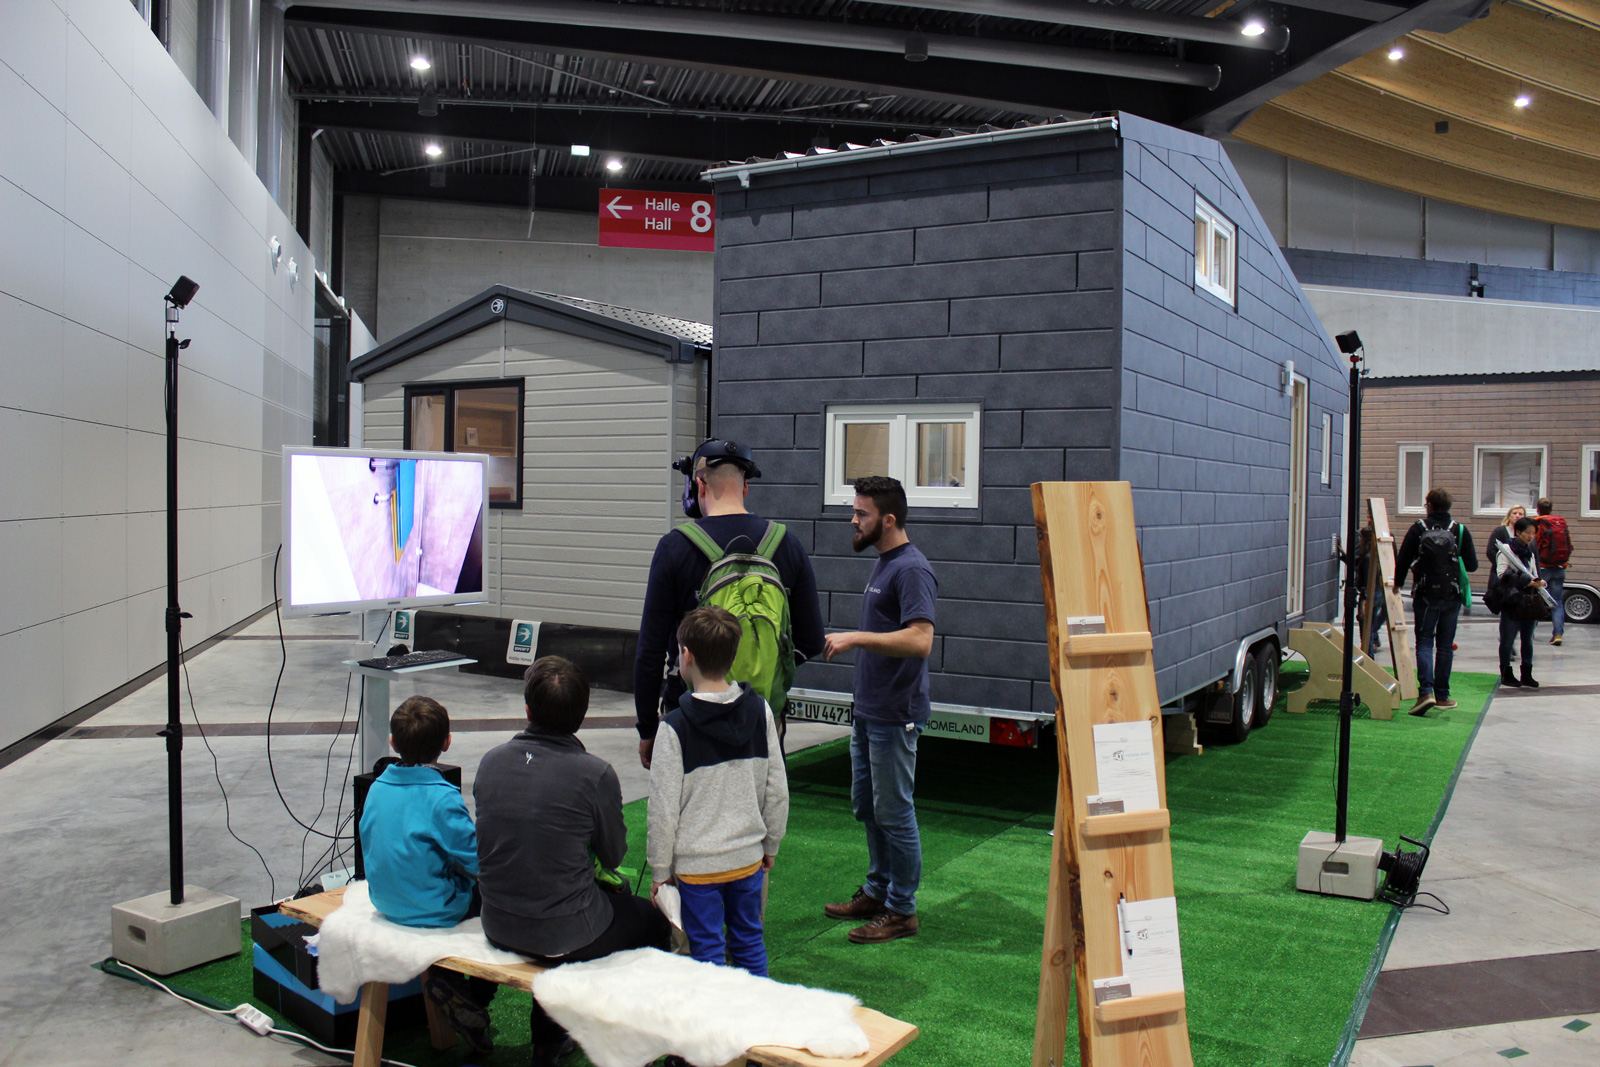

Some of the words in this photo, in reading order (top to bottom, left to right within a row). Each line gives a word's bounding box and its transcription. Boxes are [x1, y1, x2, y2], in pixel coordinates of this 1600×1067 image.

[645, 197, 680, 212] Halle
[644, 217, 672, 231] Hall
[690, 200, 712, 233] 8
[789, 701, 796, 716] B
[805, 703, 820, 719] UV
[822, 705, 852, 724] 4471
[925, 719, 985, 736] HOMELAND
